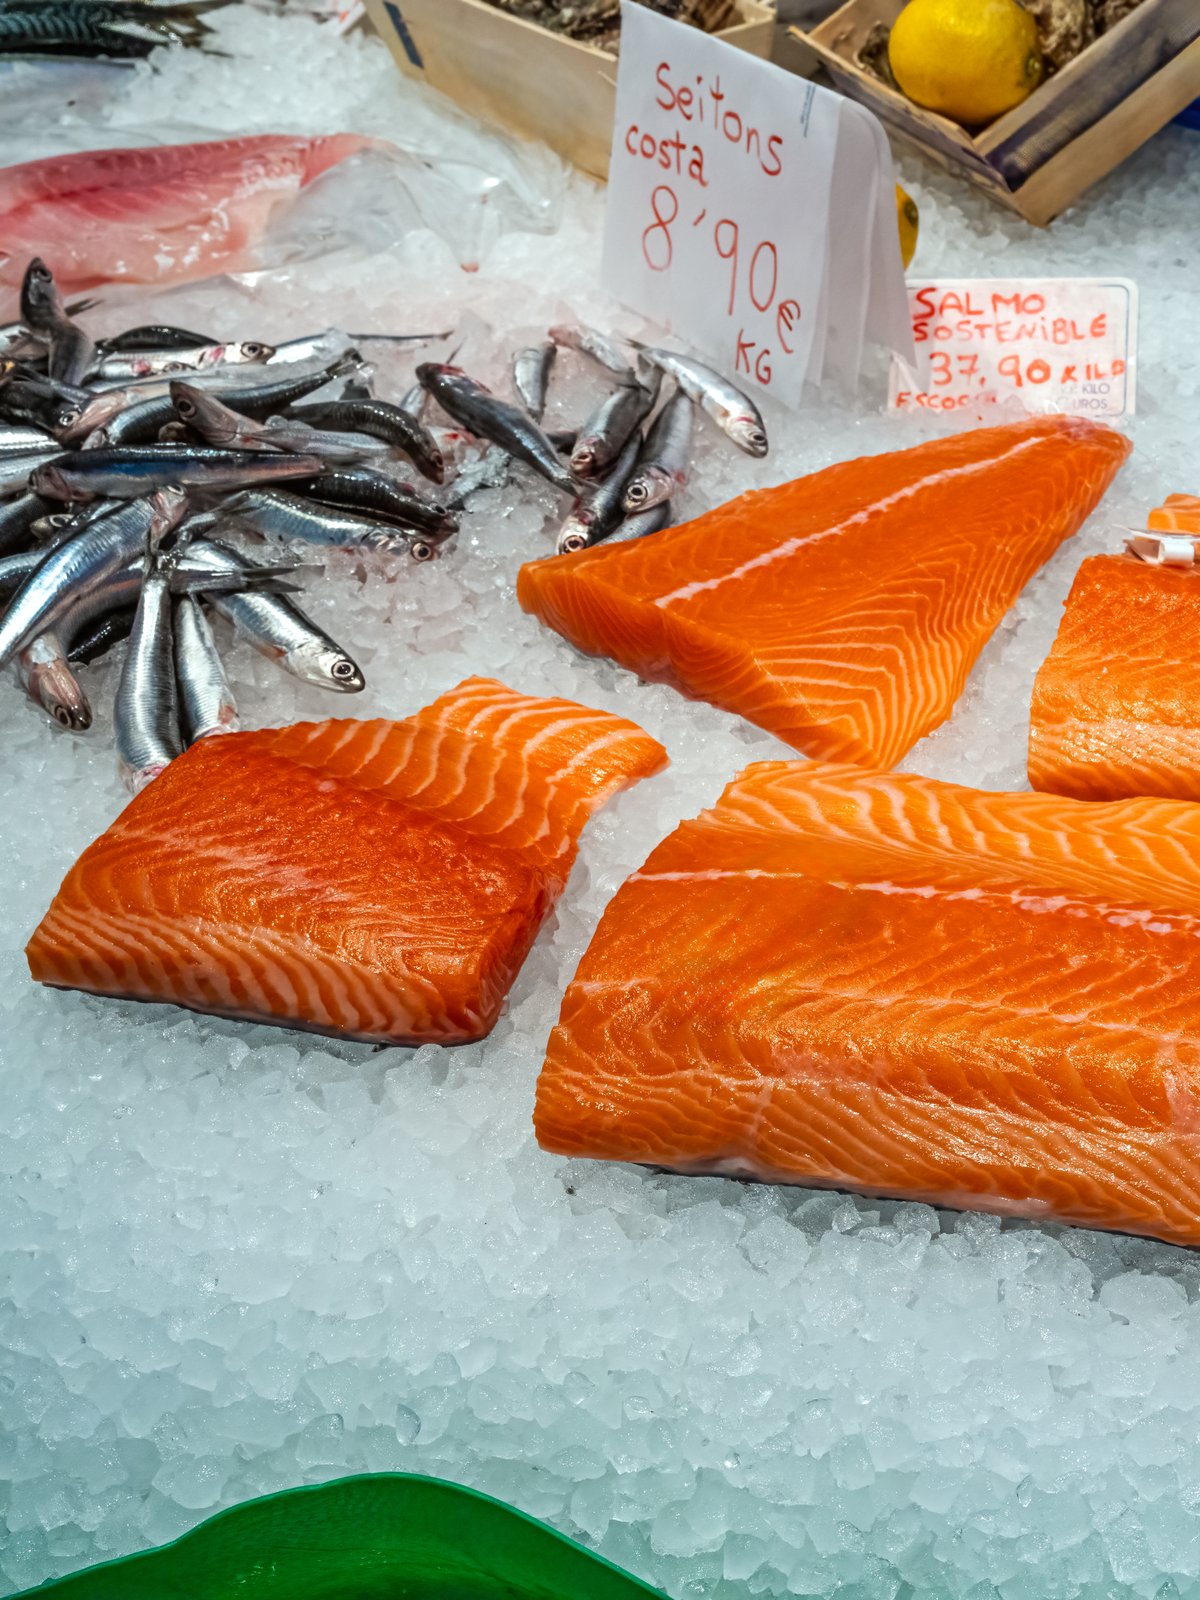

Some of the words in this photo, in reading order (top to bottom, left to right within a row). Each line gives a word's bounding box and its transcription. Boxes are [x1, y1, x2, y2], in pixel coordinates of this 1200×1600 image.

[655, 61, 783, 176] Seitons
[625, 124, 708, 187] costa
[912, 287, 1046, 321] SALMO
[735, 329, 772, 385] KG
[1060, 358, 1127, 385] KILO
